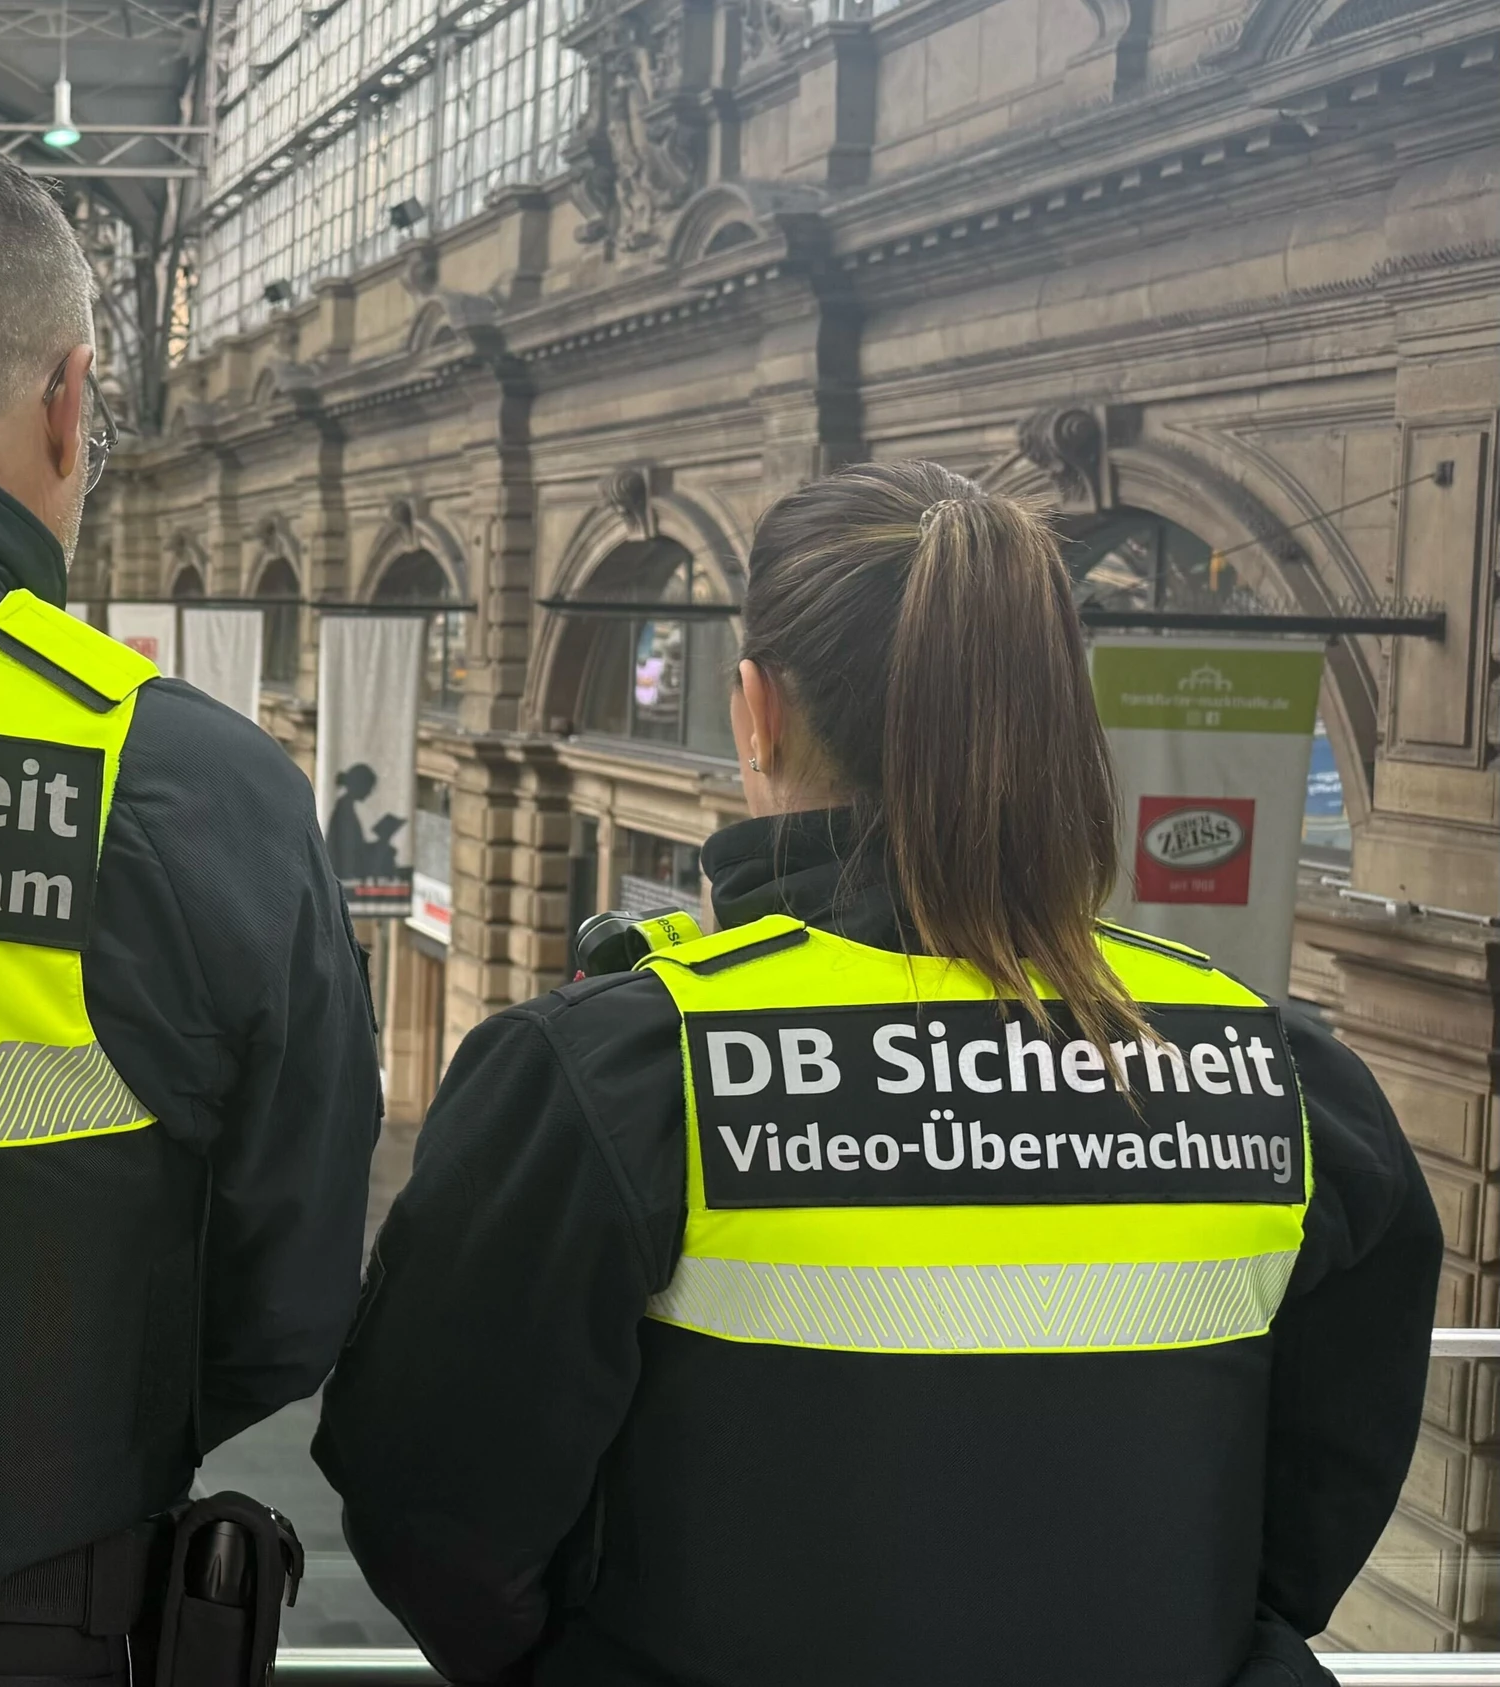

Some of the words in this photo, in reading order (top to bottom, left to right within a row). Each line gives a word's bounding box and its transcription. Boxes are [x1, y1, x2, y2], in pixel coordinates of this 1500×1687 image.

[1157, 820, 1232, 855] ZEISS
[706, 1027, 841, 1097] DB
[873, 1020, 1285, 1097] Sicherheit
[717, 1108, 1292, 1184] Video-Überwachung
